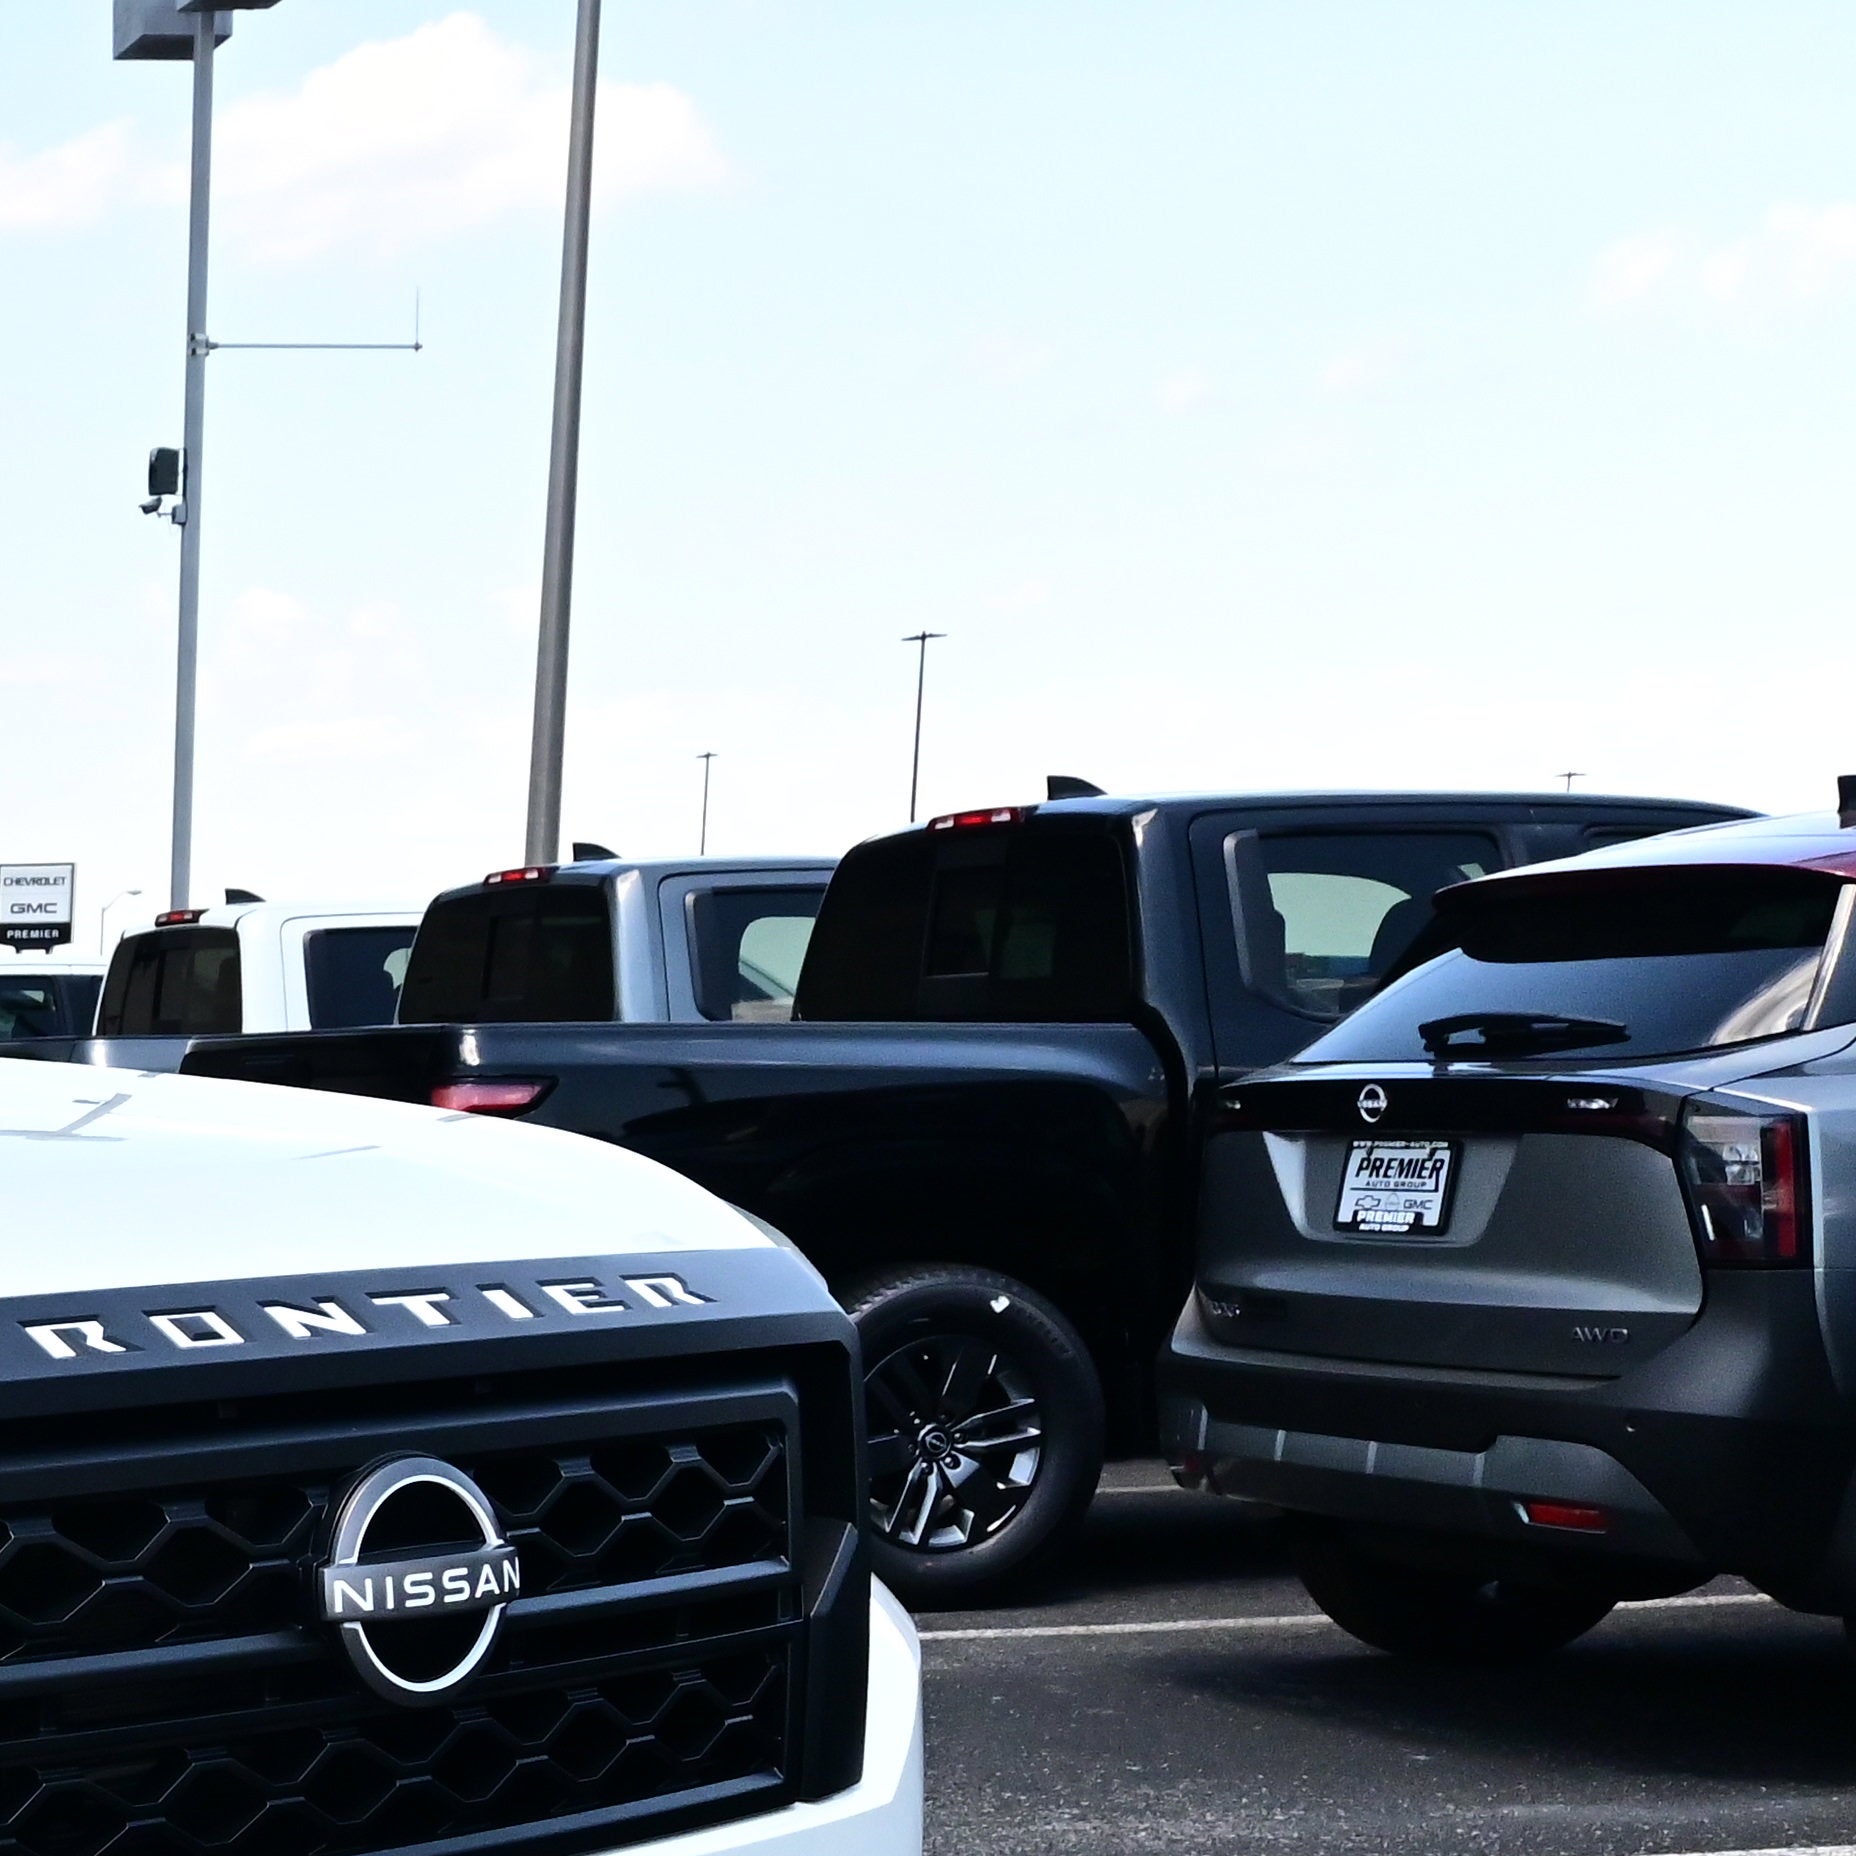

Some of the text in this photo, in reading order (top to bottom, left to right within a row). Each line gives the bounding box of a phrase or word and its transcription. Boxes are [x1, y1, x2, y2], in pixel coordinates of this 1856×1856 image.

[3, 876, 66, 887] CHEVROLET
[10, 902, 57, 914] GMC
[6, 929, 59, 939] PREMIER
[1355, 1157, 1446, 1180] PREMIER
[1403, 1199, 1433, 1210] GMC
[1356, 1211, 1416, 1224] PREMIER
[1572, 1326, 1629, 1342] AWD
[333, 1556, 521, 1613] NISSAN
